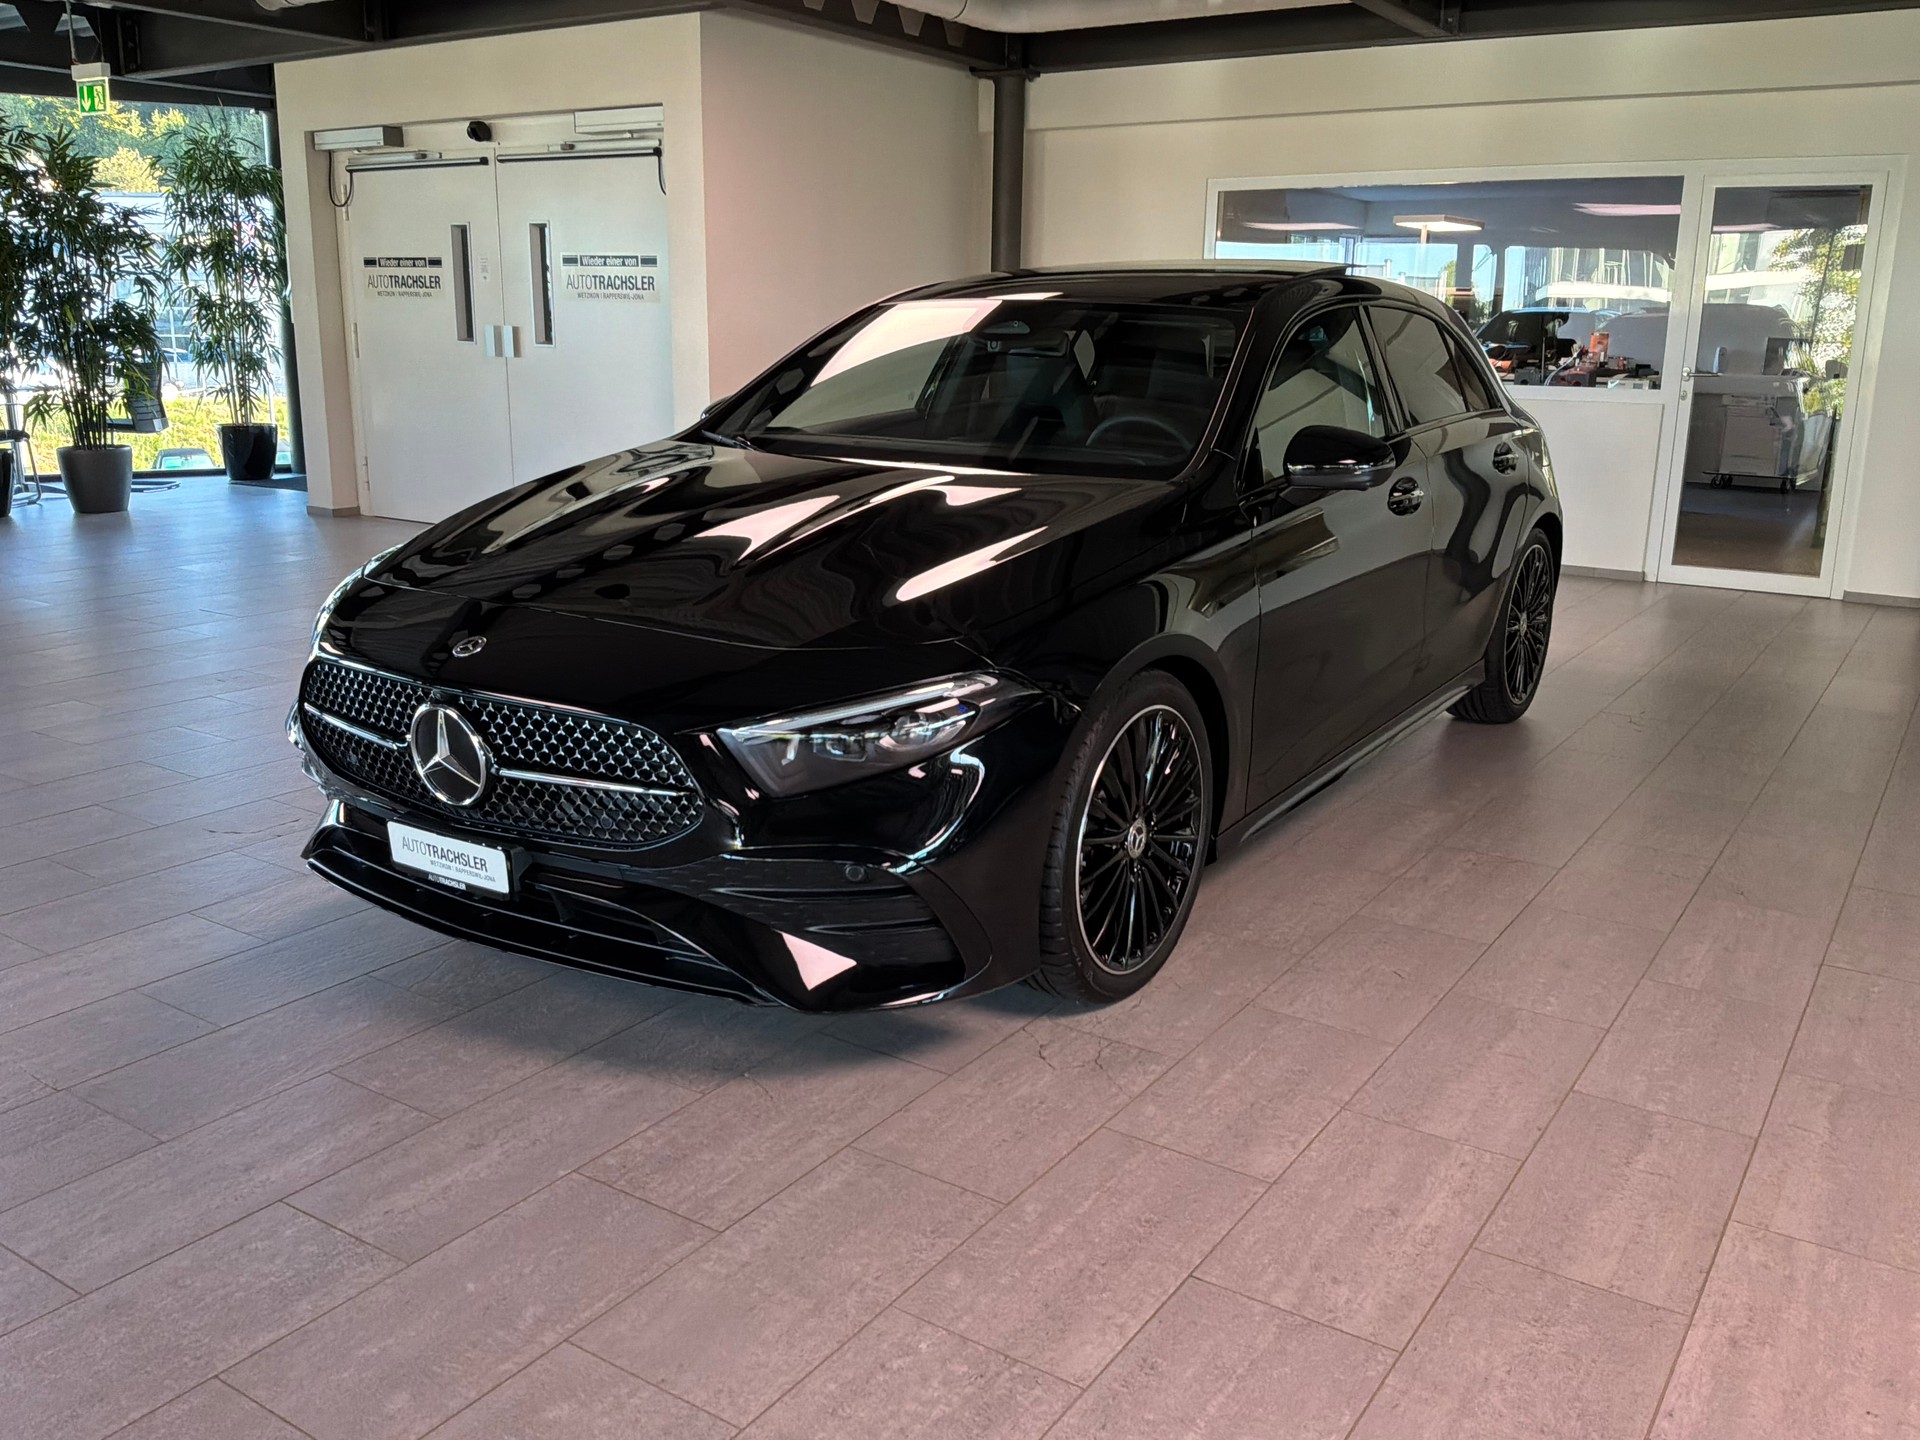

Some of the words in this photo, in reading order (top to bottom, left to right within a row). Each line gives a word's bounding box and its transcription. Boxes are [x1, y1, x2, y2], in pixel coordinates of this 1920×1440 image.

[380, 258, 399, 267] Wieder
[400, 258, 414, 267] einer
[414, 259, 426, 267] von
[581, 256, 605, 266] Wieder
[605, 256, 623, 266] einer
[624, 258, 637, 266] von
[367, 274, 442, 290] AUTOTRACHSLER
[566, 274, 656, 291] AUTOTRACHSLER
[402, 836, 489, 873] AUTOTRACHSLER
